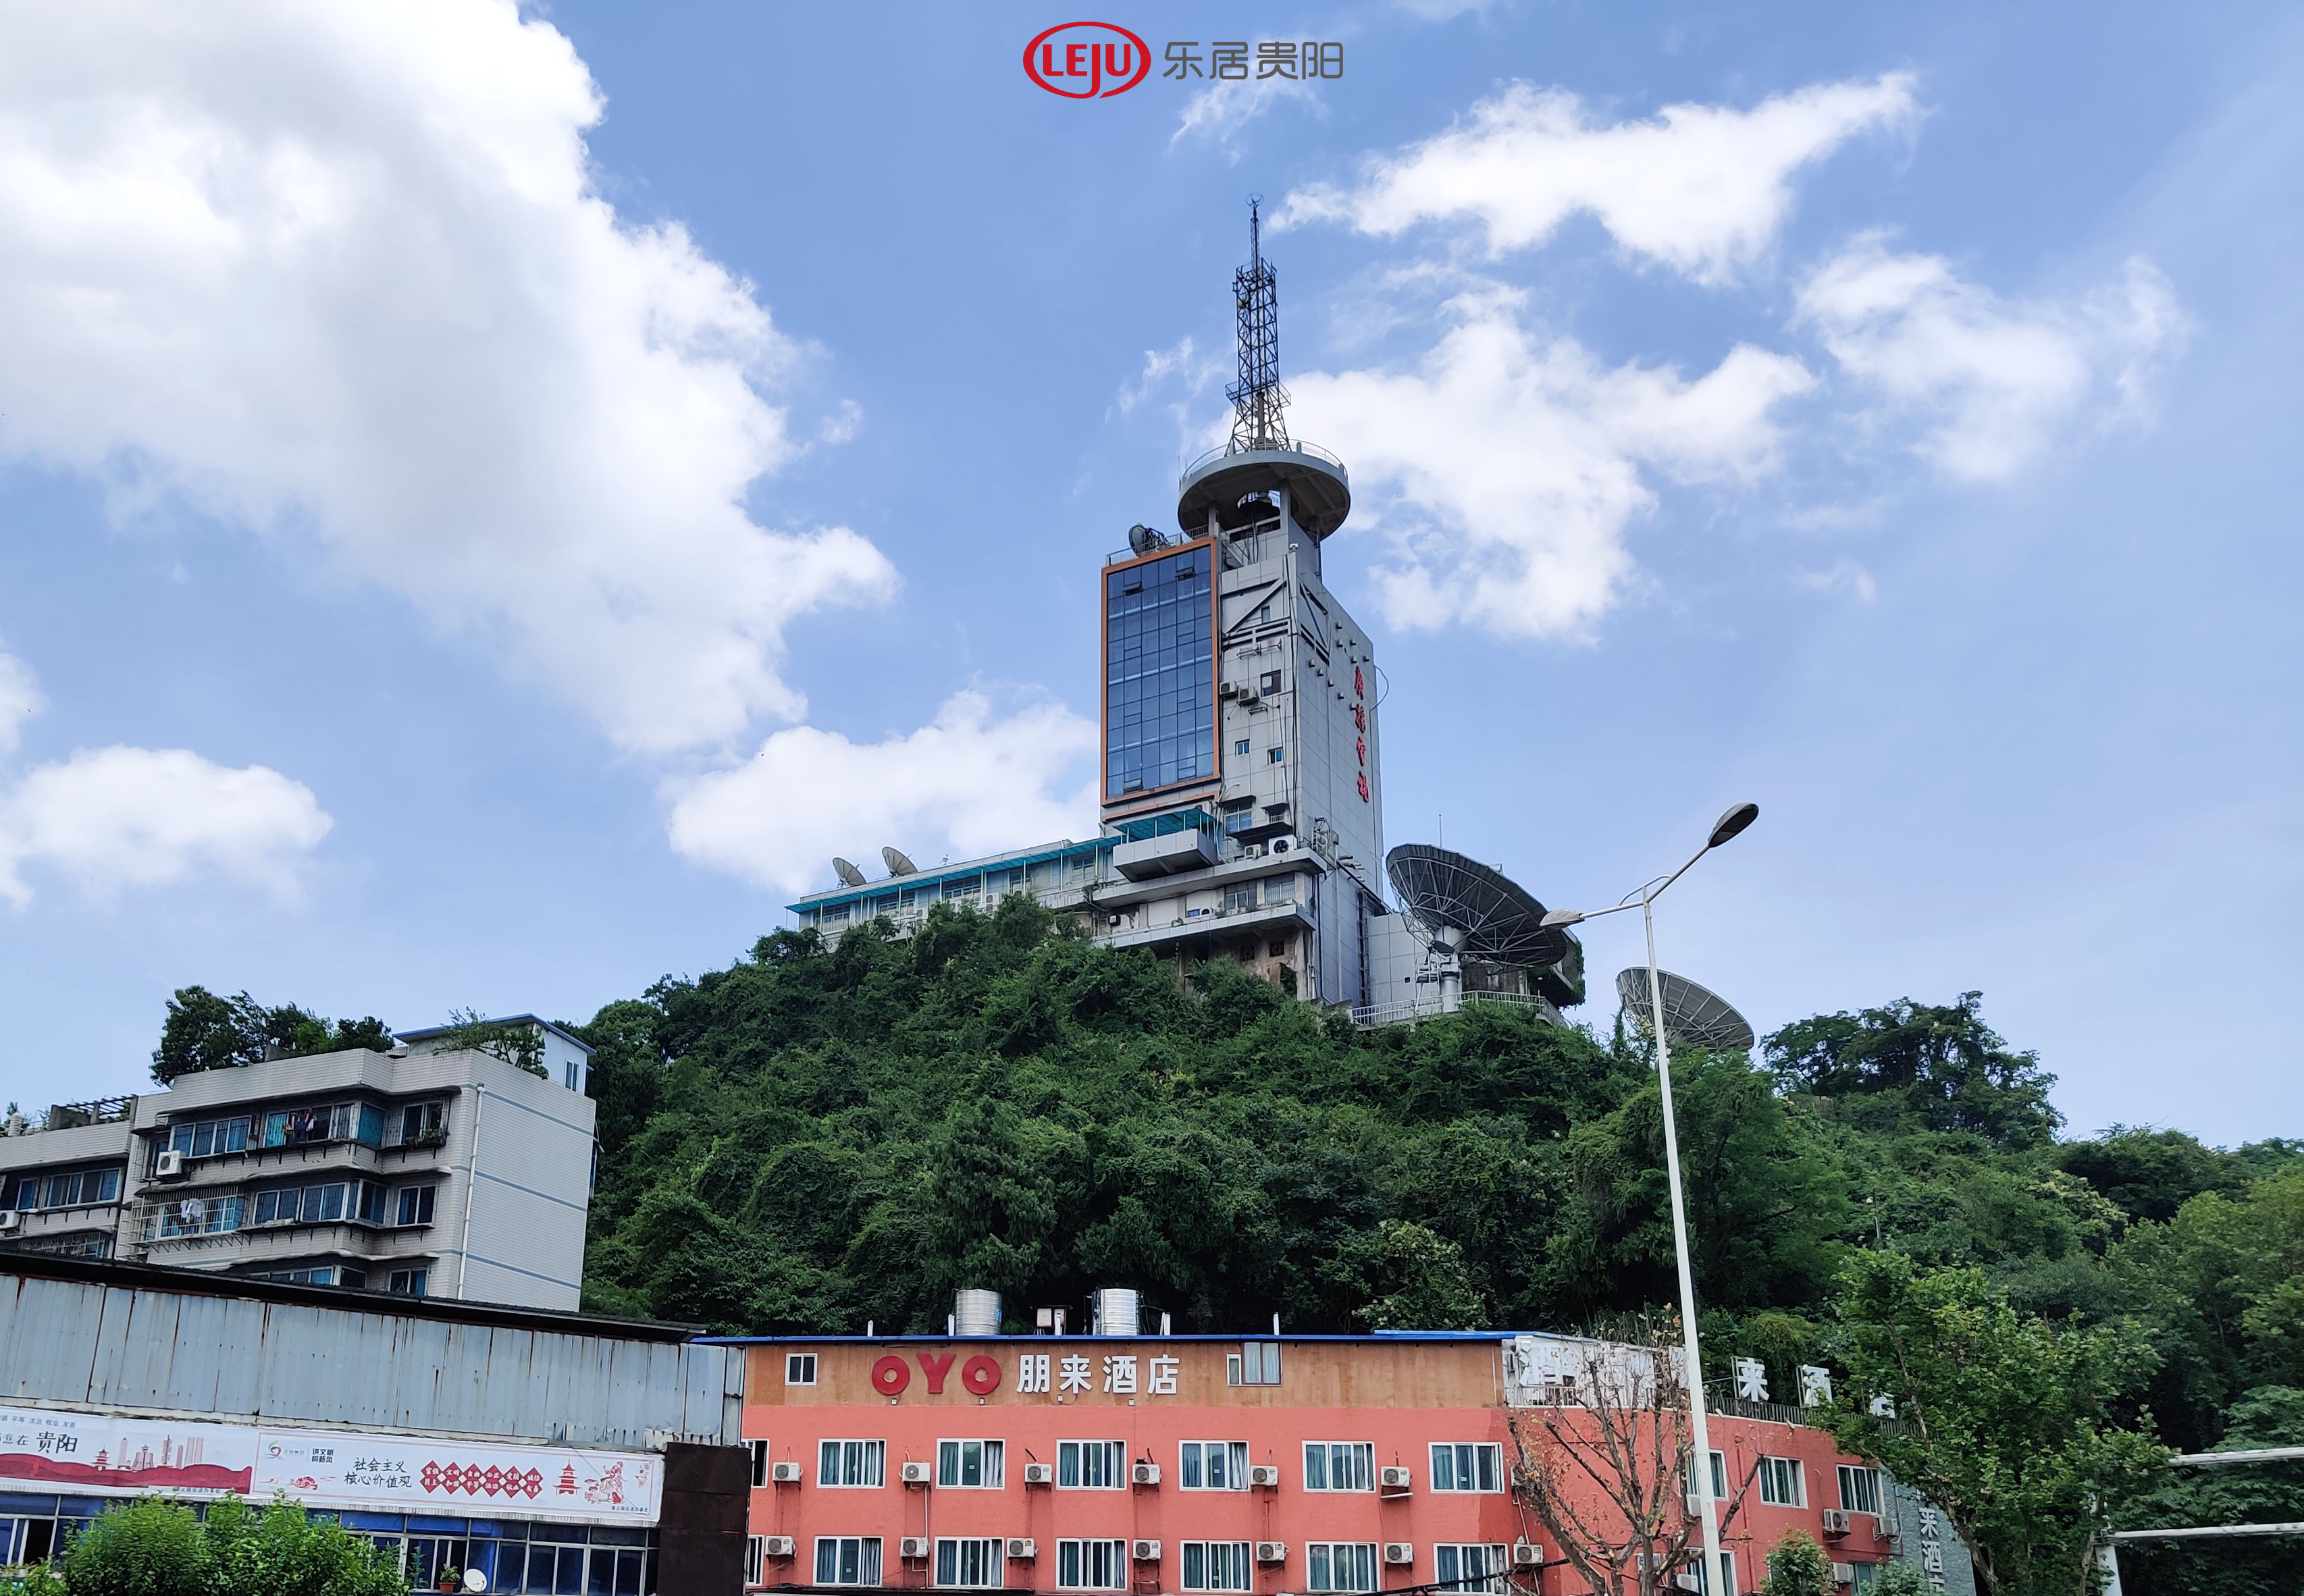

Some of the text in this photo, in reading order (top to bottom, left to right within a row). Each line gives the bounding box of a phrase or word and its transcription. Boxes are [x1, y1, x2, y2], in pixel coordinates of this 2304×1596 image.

[871, 1353, 1180, 1396] OYO 朋来酒店
[36, 1431, 78, 1454] 贵阳
[352, 1457, 407, 1473] 社会主义
[343, 1471, 412, 1488] 核心价值观
